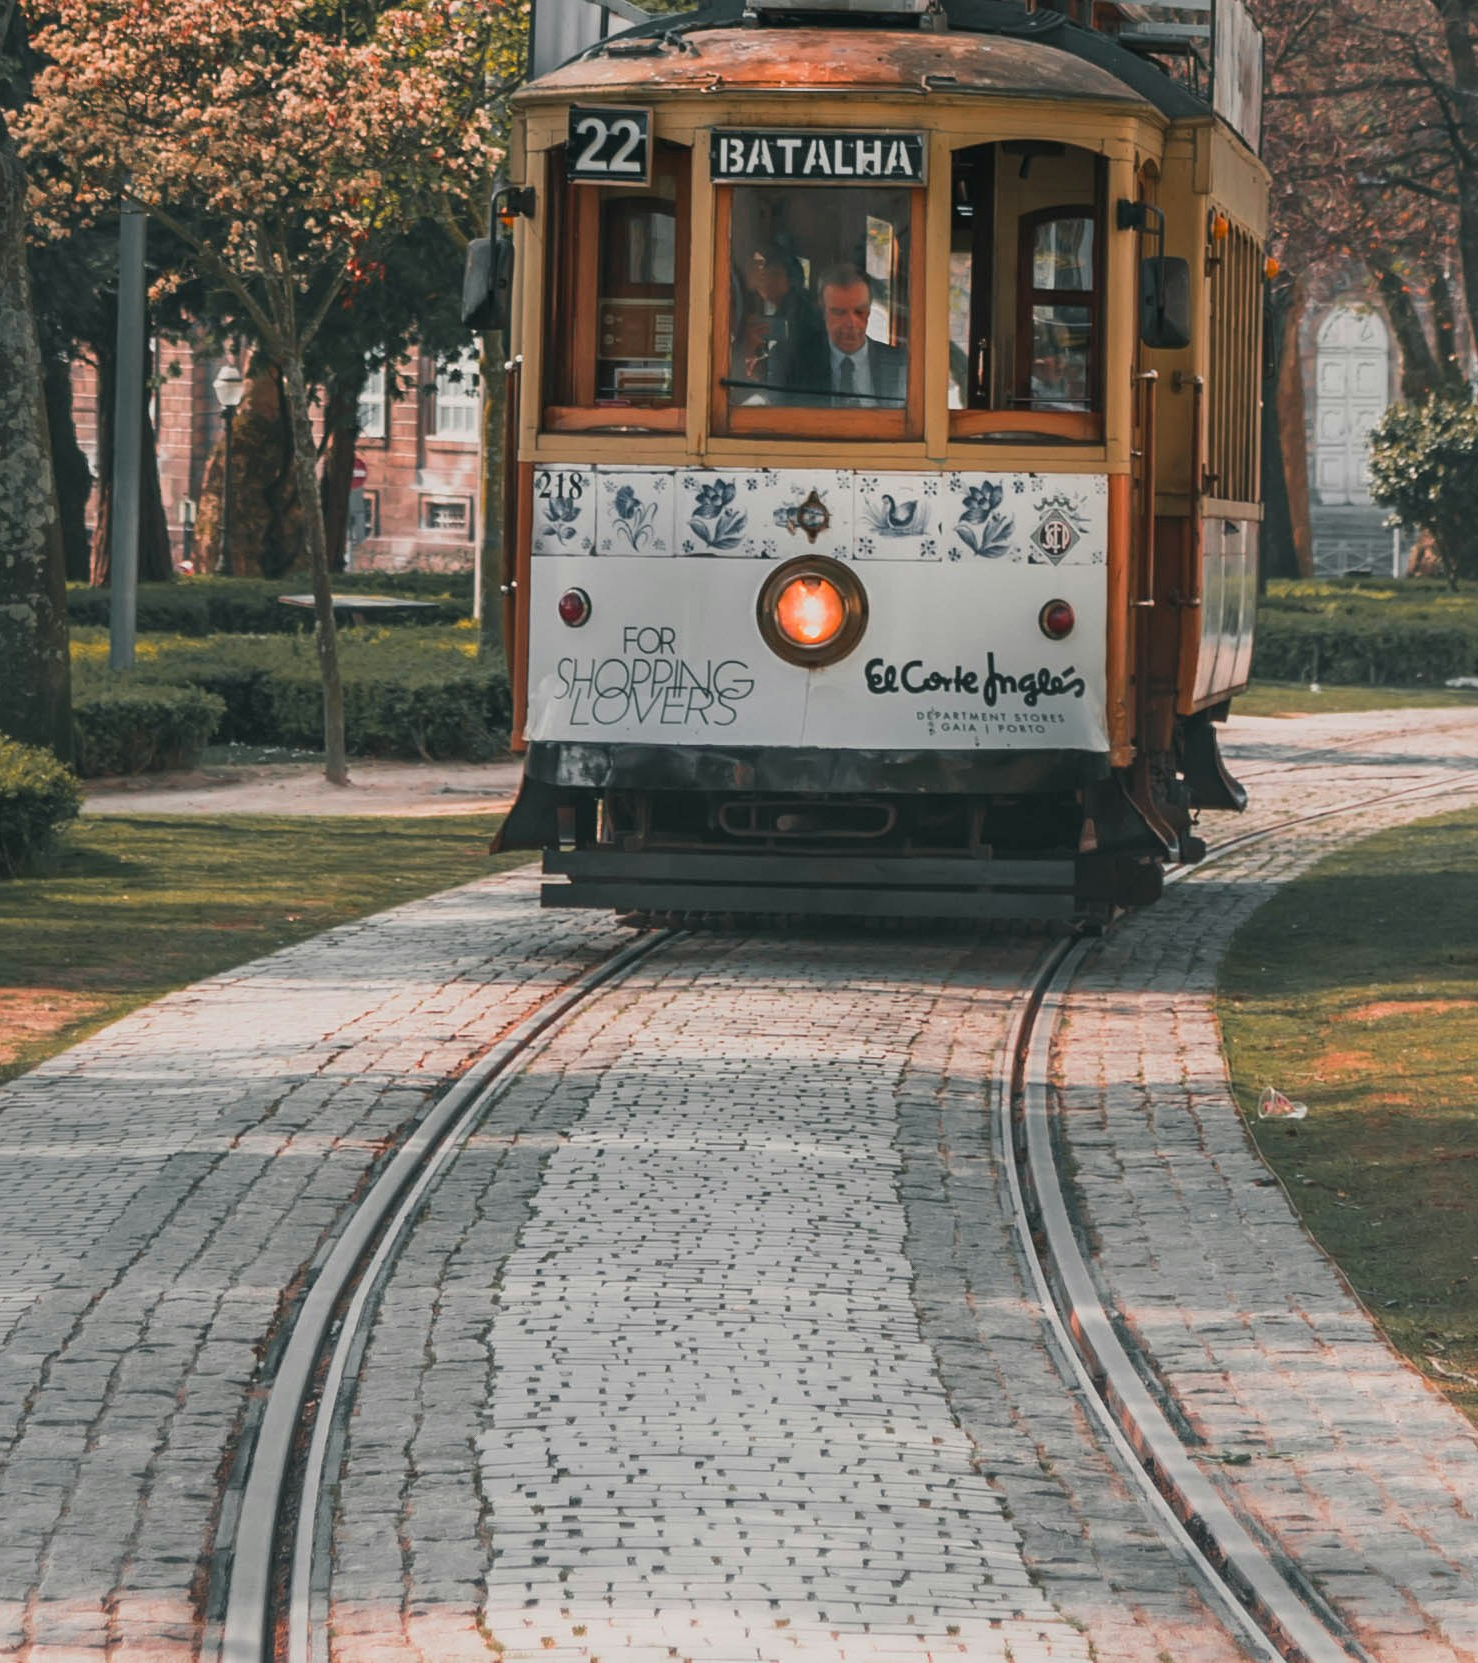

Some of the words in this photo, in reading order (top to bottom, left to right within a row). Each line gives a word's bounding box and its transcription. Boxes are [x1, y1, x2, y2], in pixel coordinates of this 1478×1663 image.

[575, 117, 641, 172] 22
[721, 138, 913, 175] BATALHA
[539, 471, 582, 499] 218
[623, 626, 676, 654] FOR
[554, 657, 755, 700] SHOPPING
[864, 658, 899, 694] El
[901, 660, 979, 694] Corte
[983, 652, 1085, 707] Inglés
[570, 686, 737, 726] LOVERS
[916, 710, 1007, 722] DEPARTMENT
[1014, 713, 1065, 723] STORES
[941, 722, 977, 733] GAIA
[998, 724, 1046, 734] PORTO
